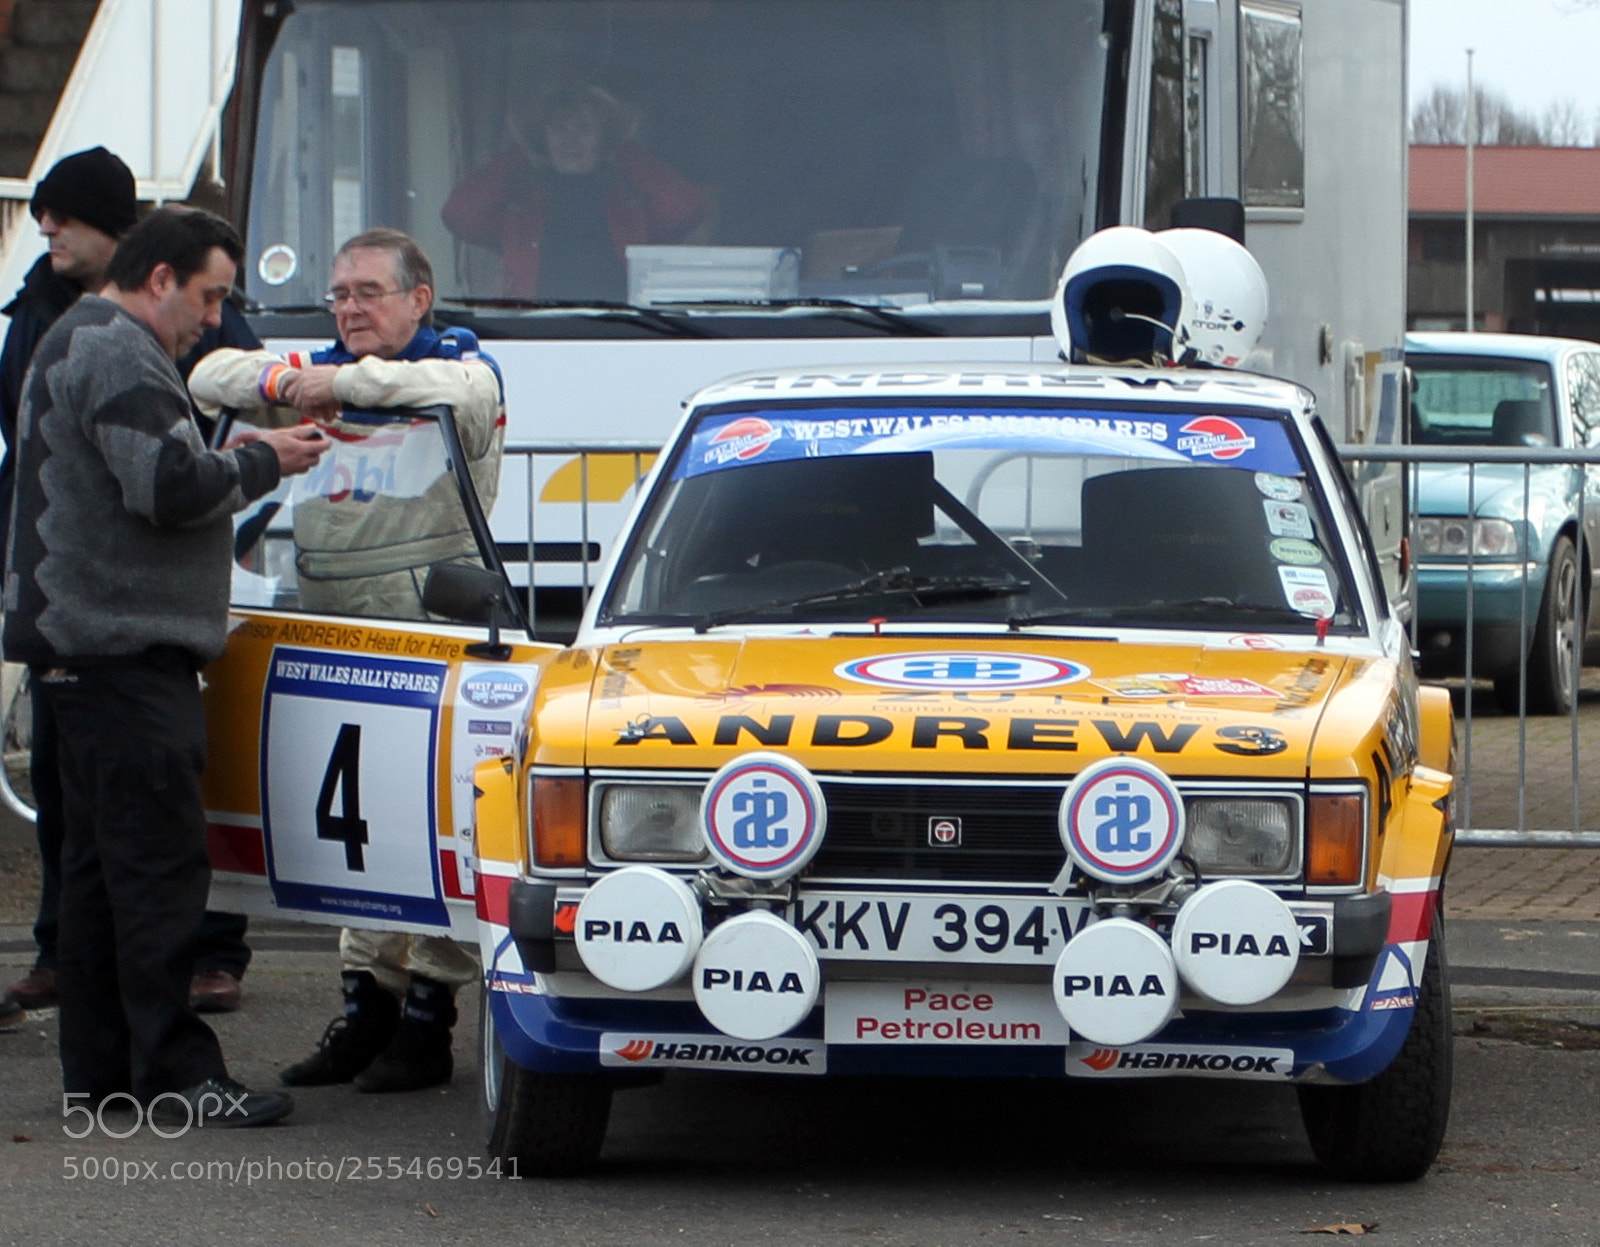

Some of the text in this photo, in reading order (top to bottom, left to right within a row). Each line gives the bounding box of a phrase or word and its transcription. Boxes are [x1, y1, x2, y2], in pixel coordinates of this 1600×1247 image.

[794, 420, 869, 440] WEST
[279, 622, 362, 648] ANDREWS
[365, 631, 401, 651] Heat
[403, 636, 425, 653] for
[428, 637, 460, 658] Hire
[275, 660, 440, 694] WEST WALES RALLY SPARES
[467, 682, 524, 692] WEST WALES
[613, 714, 1288, 756] ANDREWS
[316, 723, 369, 873] 4
[584, 920, 683, 944] PIAA
[795, 900, 1091, 955] KKV 394V
[1191, 932, 1291, 957] PIAA
[703, 968, 804, 994] PIAA
[1064, 974, 1166, 997] PIAA
[904, 988, 993, 1012] Pace
[856, 1017, 1041, 1040] Petroleum
